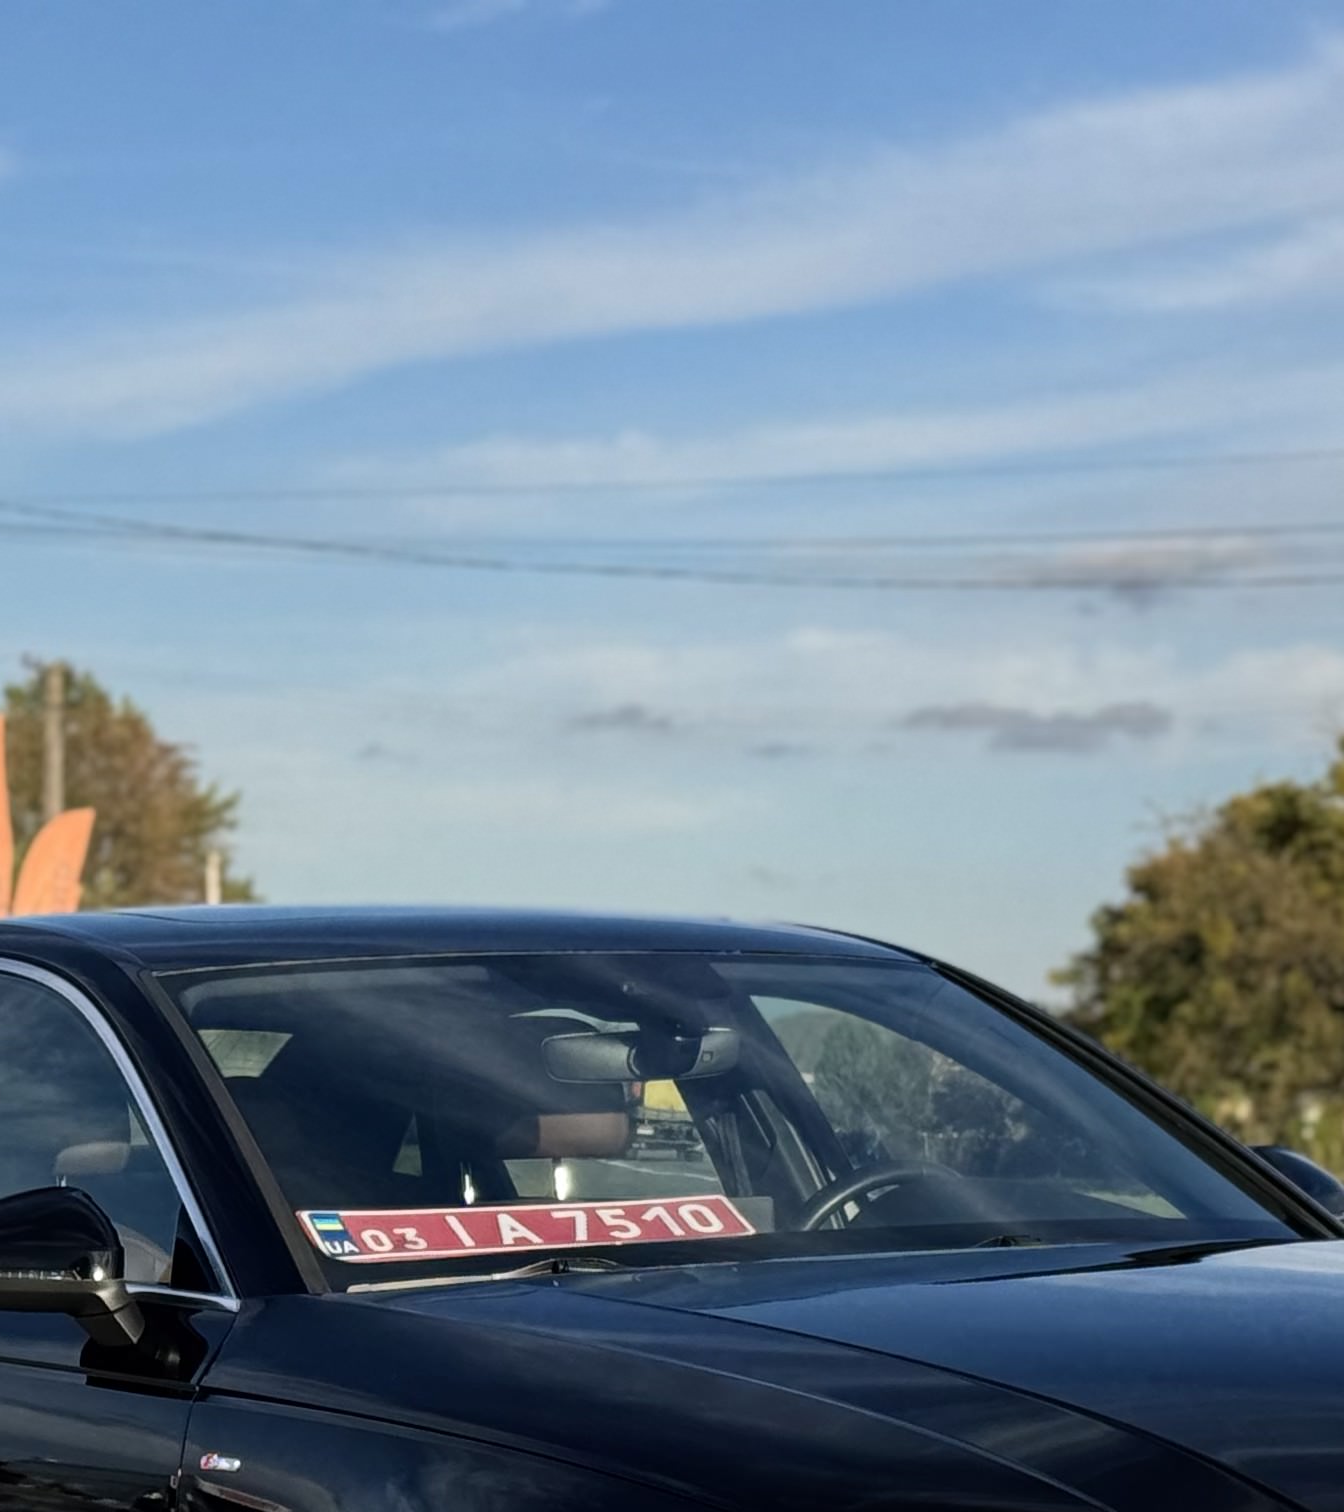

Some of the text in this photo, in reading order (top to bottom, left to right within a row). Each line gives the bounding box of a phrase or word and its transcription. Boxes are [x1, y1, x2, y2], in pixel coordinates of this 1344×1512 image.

[360, 1227, 428, 1252] 03
[551, 1202, 725, 1244] 7510
[324, 1240, 360, 1254] UA
